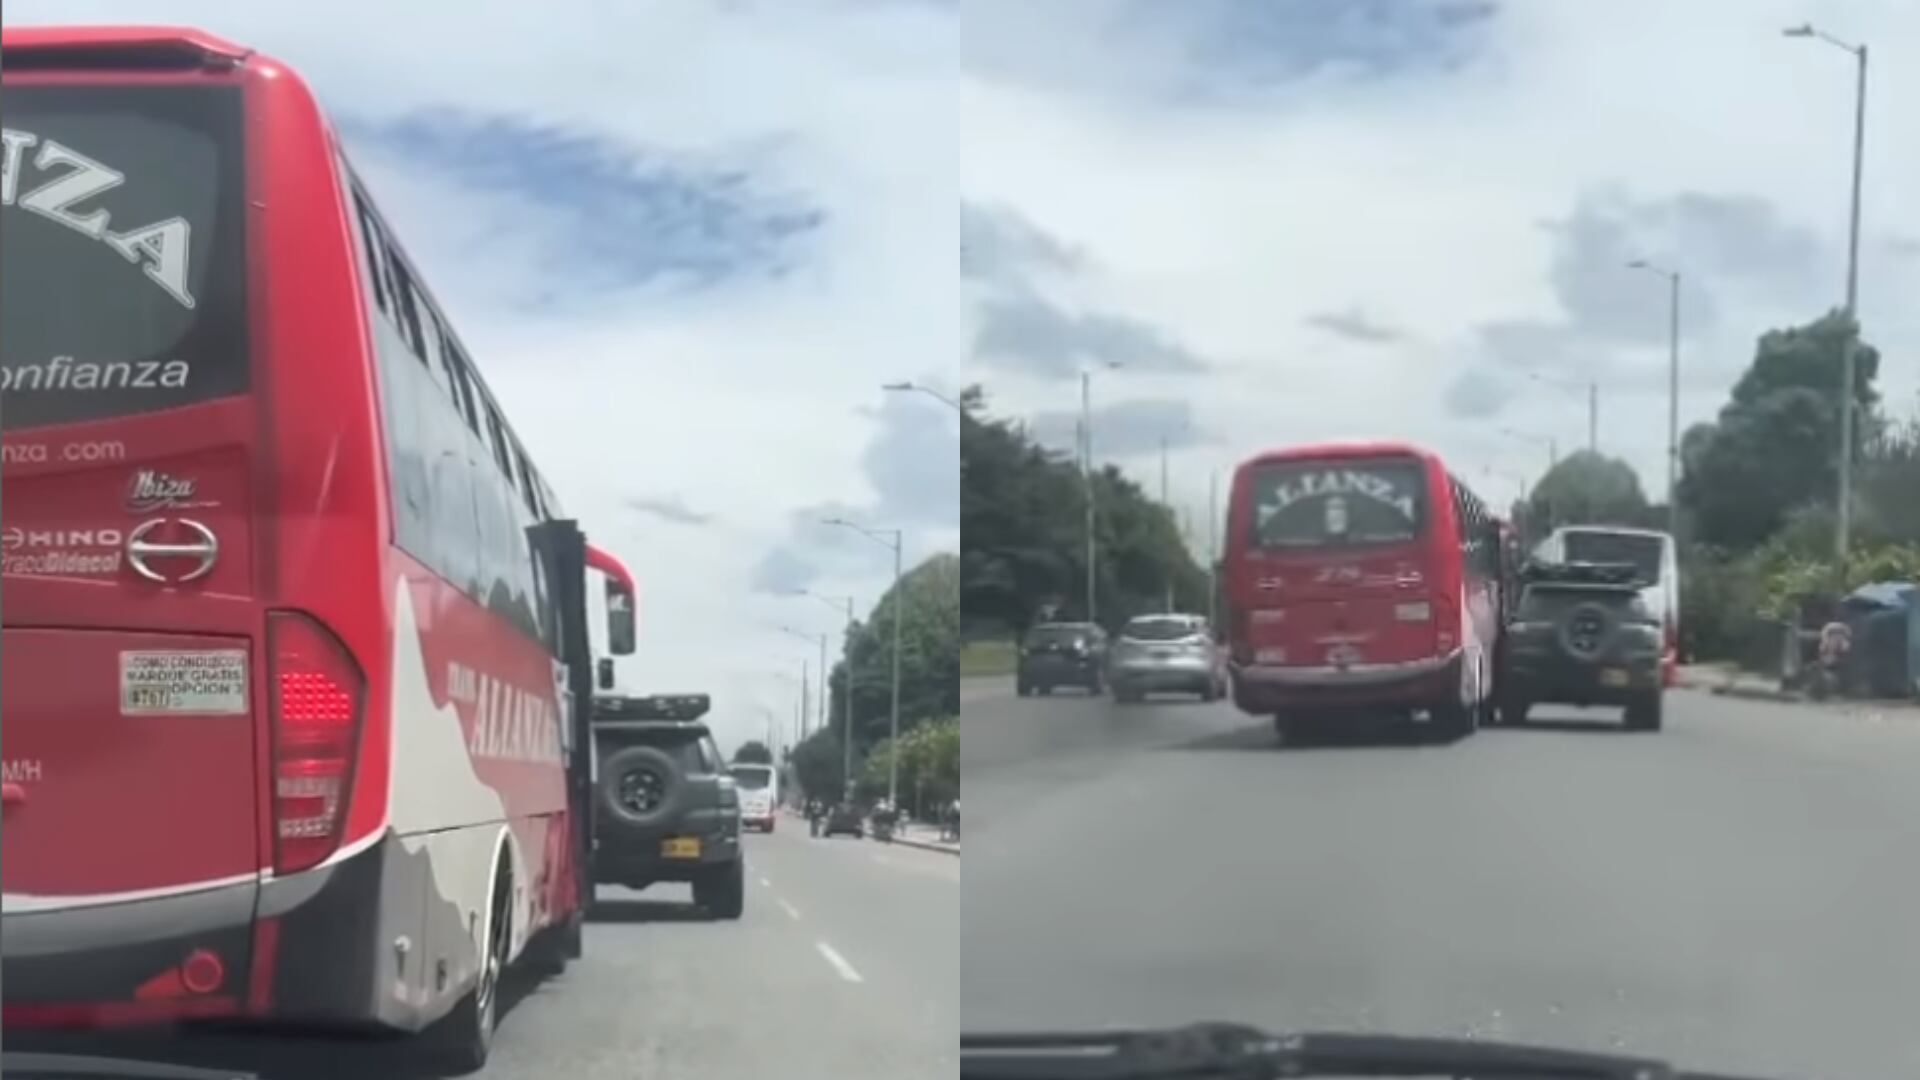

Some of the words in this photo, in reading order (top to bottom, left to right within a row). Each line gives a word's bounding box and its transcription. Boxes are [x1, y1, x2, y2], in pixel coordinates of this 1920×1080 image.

[132, 470, 194, 499] Ibiza
[1258, 470, 1415, 529] ALIANZA
[28, 529, 122, 547] HINO
[191, 669, 241, 682] GRATIS
